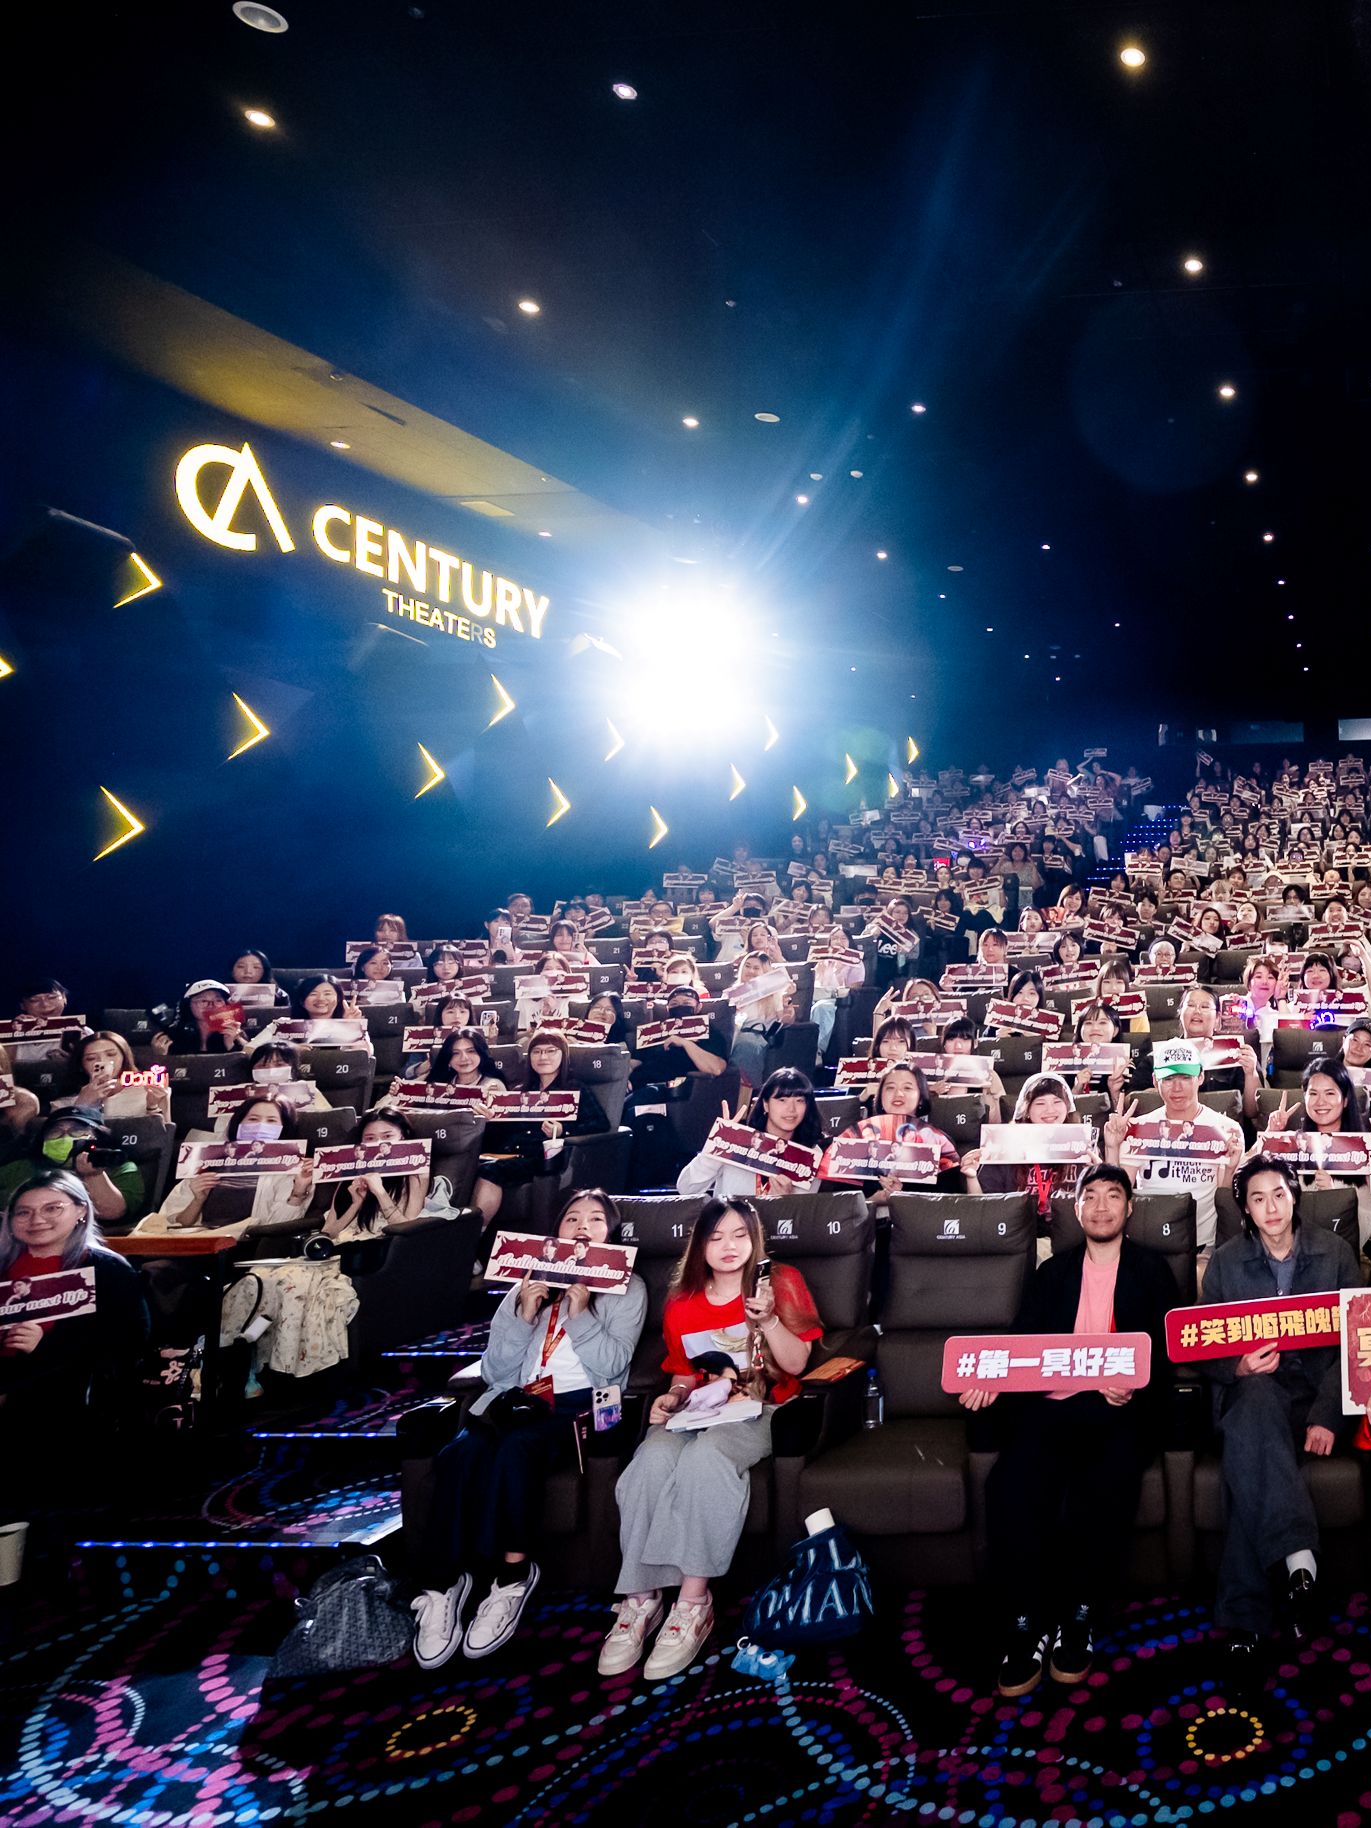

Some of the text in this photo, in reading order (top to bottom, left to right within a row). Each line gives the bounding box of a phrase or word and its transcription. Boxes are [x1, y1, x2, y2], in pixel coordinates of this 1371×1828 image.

[312, 504, 549, 639] CENTURY
[381, 587, 497, 649] THEATERS
[388, 1015, 398, 1024] 21
[1024, 1051, 1032, 1060] 16
[336, 1064, 350, 1075] 20
[592, 1060, 602, 1069] 18
[214, 1068, 226, 1078] 21
[830, 1116, 841, 1128] 17
[956, 1114, 967, 1125] 16
[1083, 1114, 1093, 1125] 15
[316, 1127, 328, 1138] 19
[435, 1129, 448, 1141] 18
[122, 1135, 138, 1146] 20
[202, 1161, 222, 1170] you
[222, 1159, 235, 1167] in
[282, 1157, 299, 1167] life
[714, 1138, 814, 1178] See you in our next life
[319, 1164, 335, 1173] See
[335, 1164, 354, 1173] you
[354, 1162, 366, 1170] in
[386, 1160, 408, 1168] next
[409, 1157, 425, 1168] life
[1171, 1166, 1181, 1178] it
[1182, 1174, 1215, 1183] Me Cry
[671, 1223, 683, 1238] 11
[827, 1221, 841, 1235] 10
[997, 1223, 1007, 1236] 9
[1162, 1223, 1171, 1236] 8
[1332, 1218, 1341, 1232] 7
[26, 1294, 62, 1310] next
[62, 1288, 88, 1306] life
[957, 1347, 1136, 1379] #第一冥好笑
